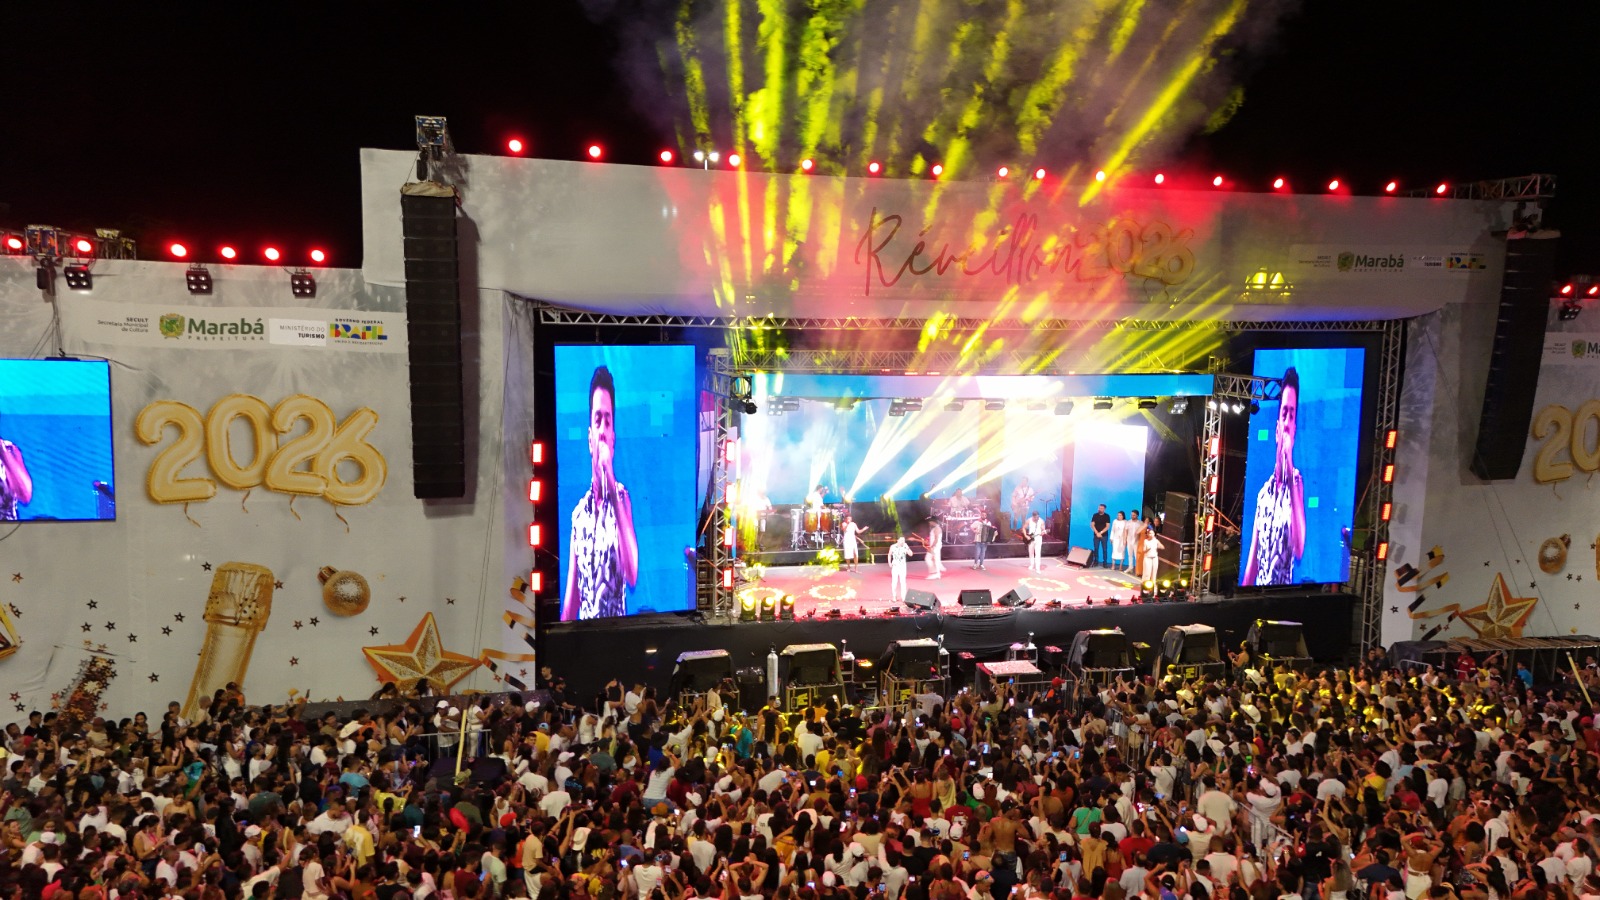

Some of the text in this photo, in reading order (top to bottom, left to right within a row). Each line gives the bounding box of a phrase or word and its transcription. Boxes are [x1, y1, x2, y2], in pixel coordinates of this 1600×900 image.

[1074, 218, 1196, 286] 2026
[1354, 254, 1404, 268] Marabá
[188, 317, 264, 335] Marabá
[329, 323, 388, 340] BRASIL
[135, 394, 387, 506] 2026
